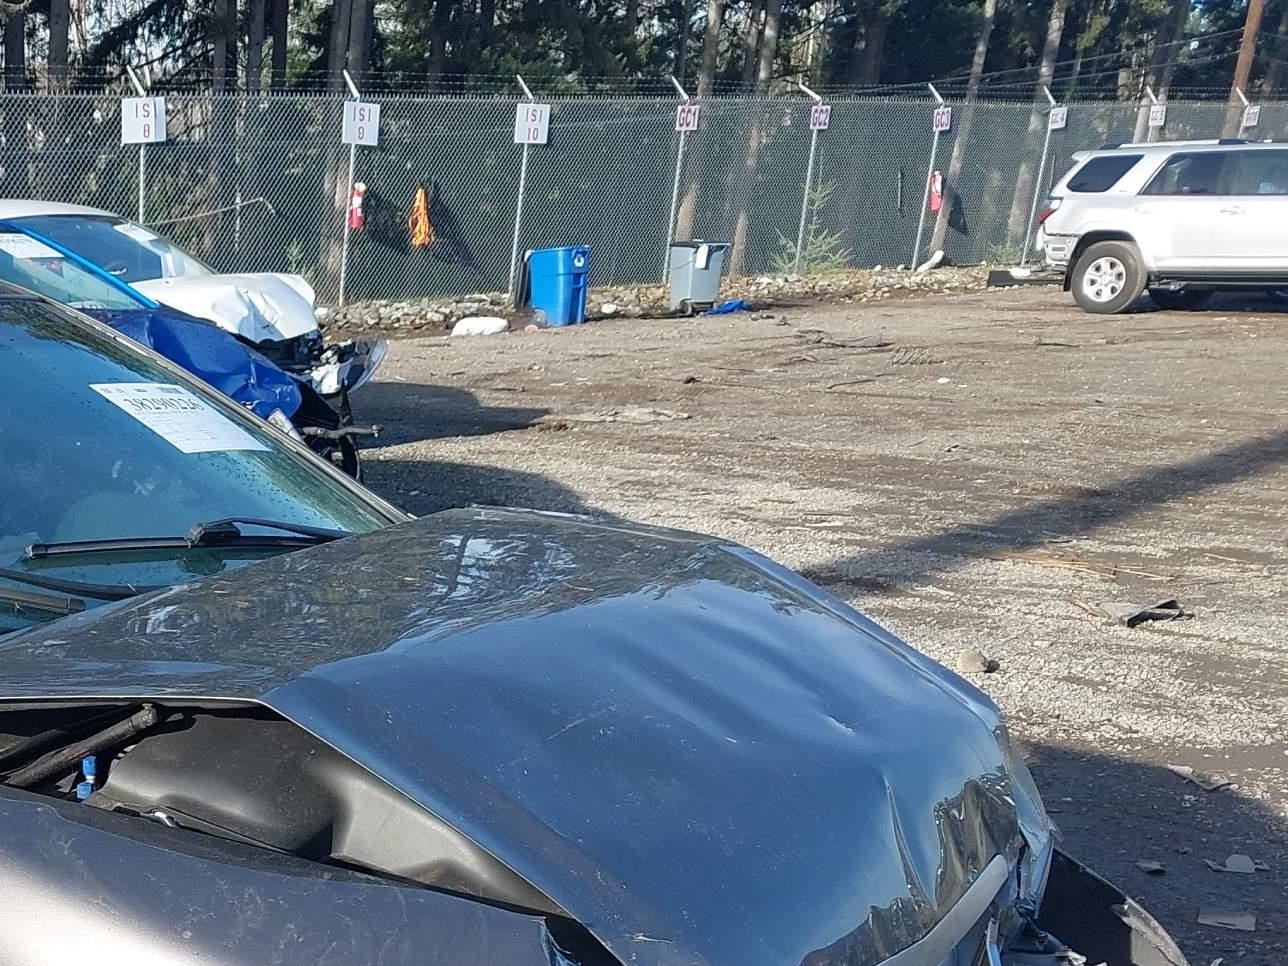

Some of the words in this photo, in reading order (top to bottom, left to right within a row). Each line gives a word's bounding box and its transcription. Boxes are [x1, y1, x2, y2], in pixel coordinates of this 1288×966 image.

[143, 123, 151, 139] 8
[358, 126, 365, 139] 9
[527, 127, 539, 141] 10
[123, 398, 206, 411] 38290226
